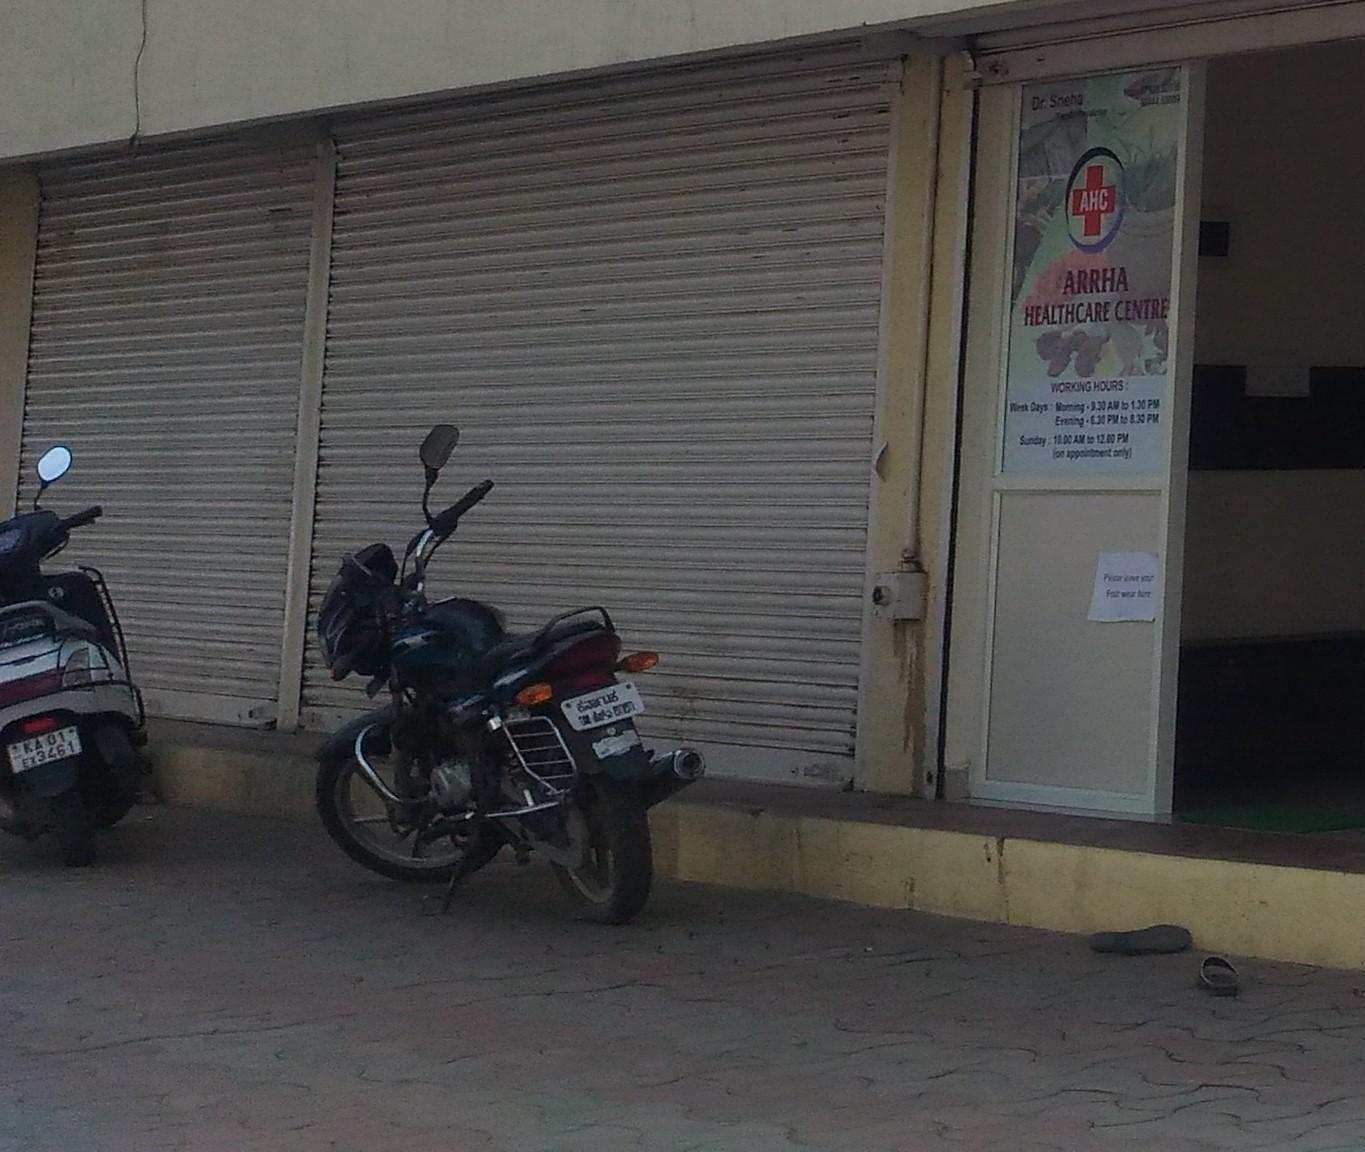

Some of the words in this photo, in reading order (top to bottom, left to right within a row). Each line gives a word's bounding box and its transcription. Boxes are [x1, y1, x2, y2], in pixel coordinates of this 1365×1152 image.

[1079, 189, 1108, 212] AHC
[1063, 267, 1129, 295] ARRHA
[1024, 301, 1110, 326] HEALTHCARE
[1114, 298, 1168, 322] CENTRE
[1051, 381, 1092, 393] WORKING
[1094, 380, 1124, 391] HOURS
